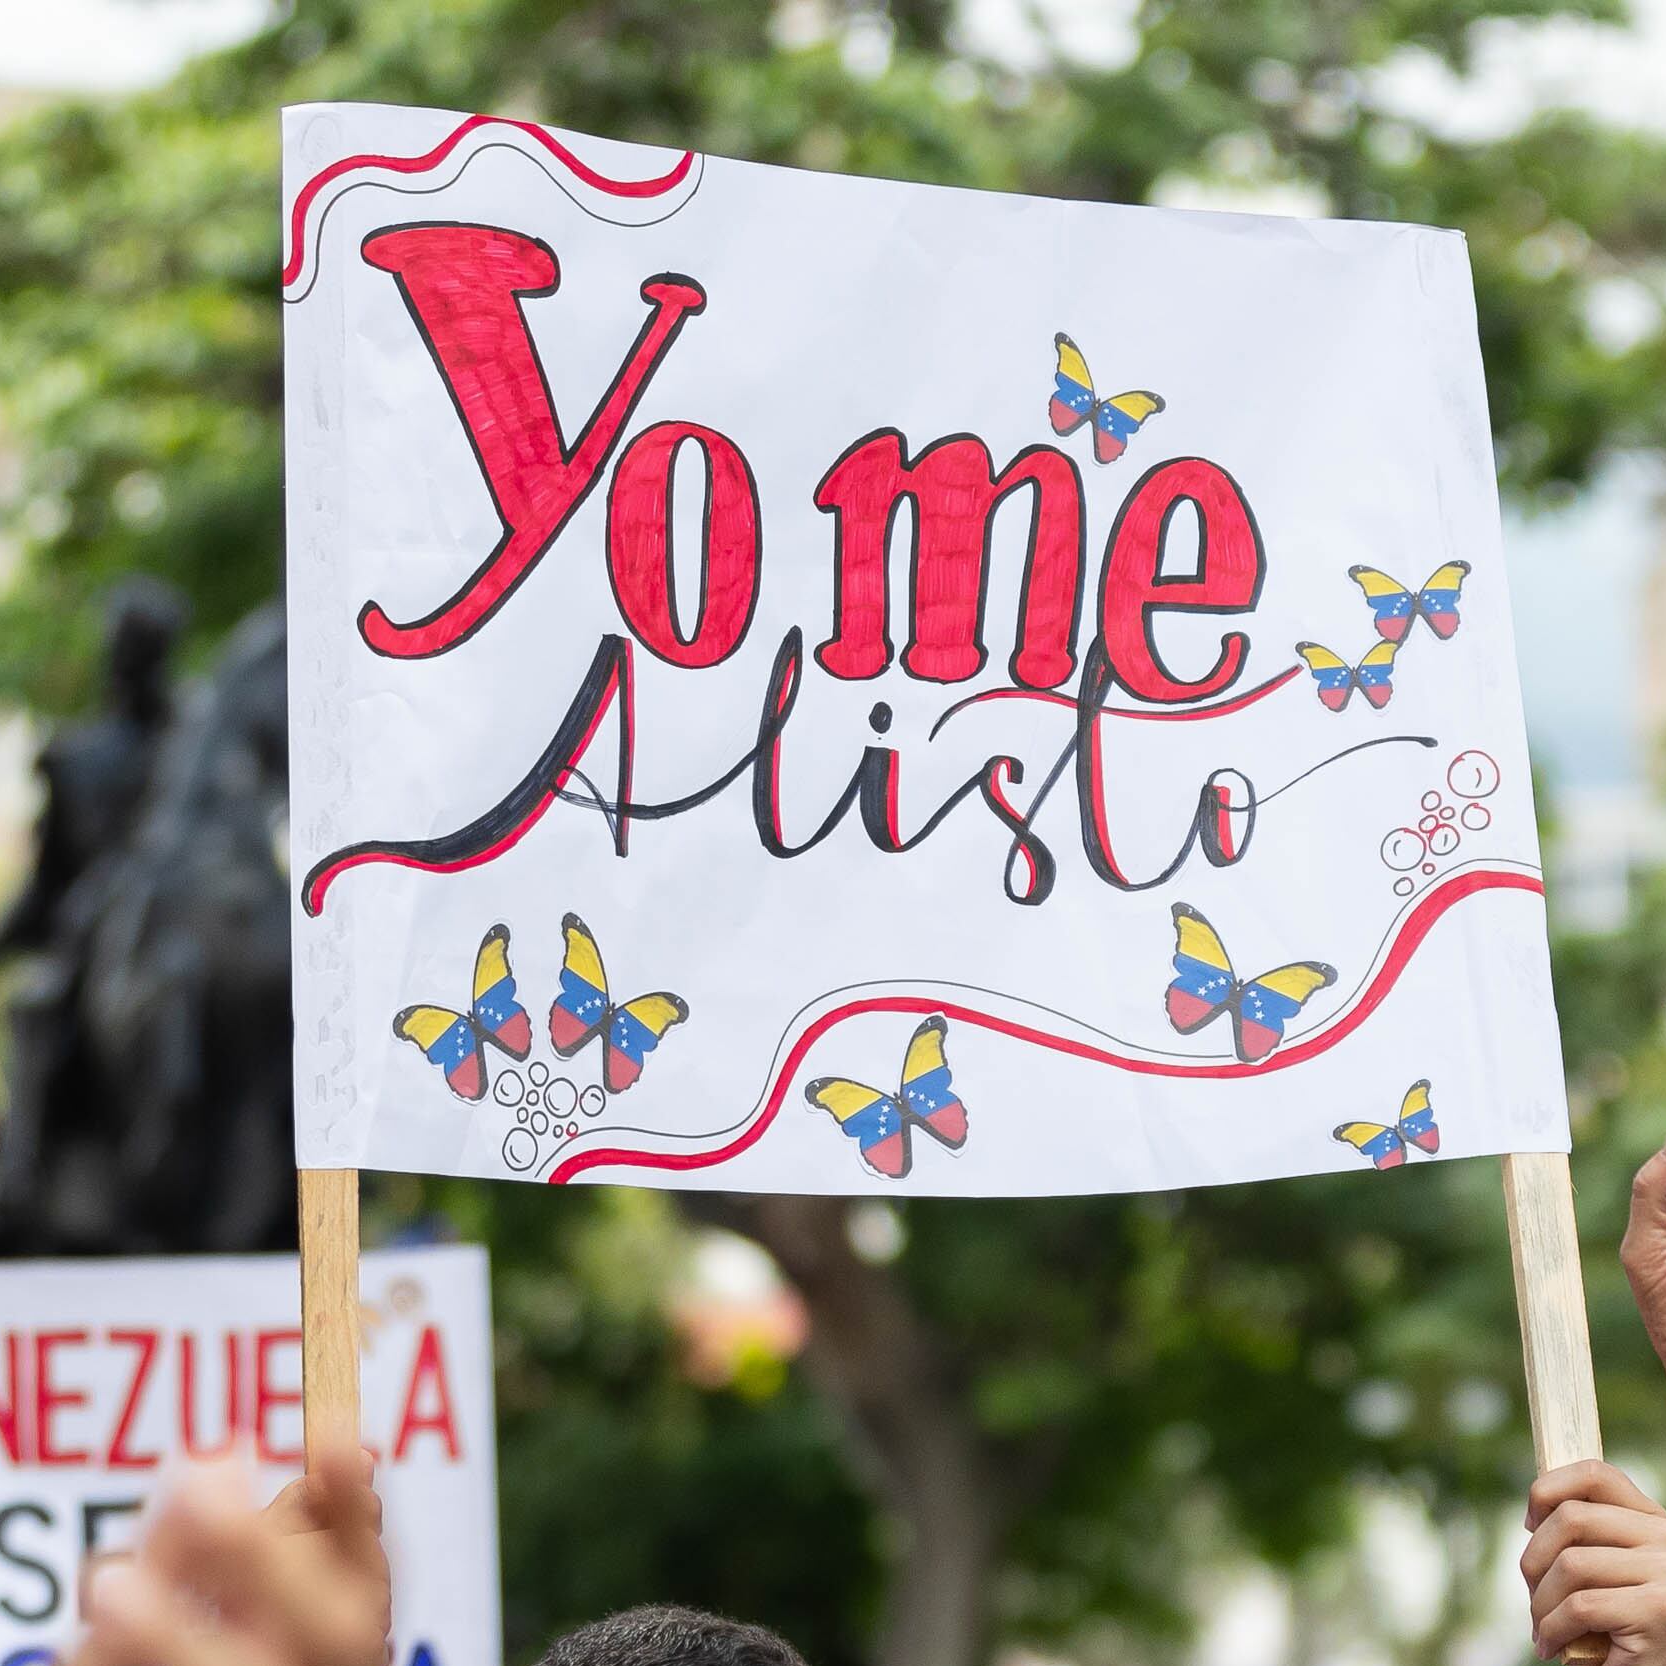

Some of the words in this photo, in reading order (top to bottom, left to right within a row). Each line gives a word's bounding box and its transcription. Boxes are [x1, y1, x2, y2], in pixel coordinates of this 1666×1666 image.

[355, 218, 763, 669] Yo
[813, 430, 1267, 703] me
[302, 626, 1439, 914] Alisto
